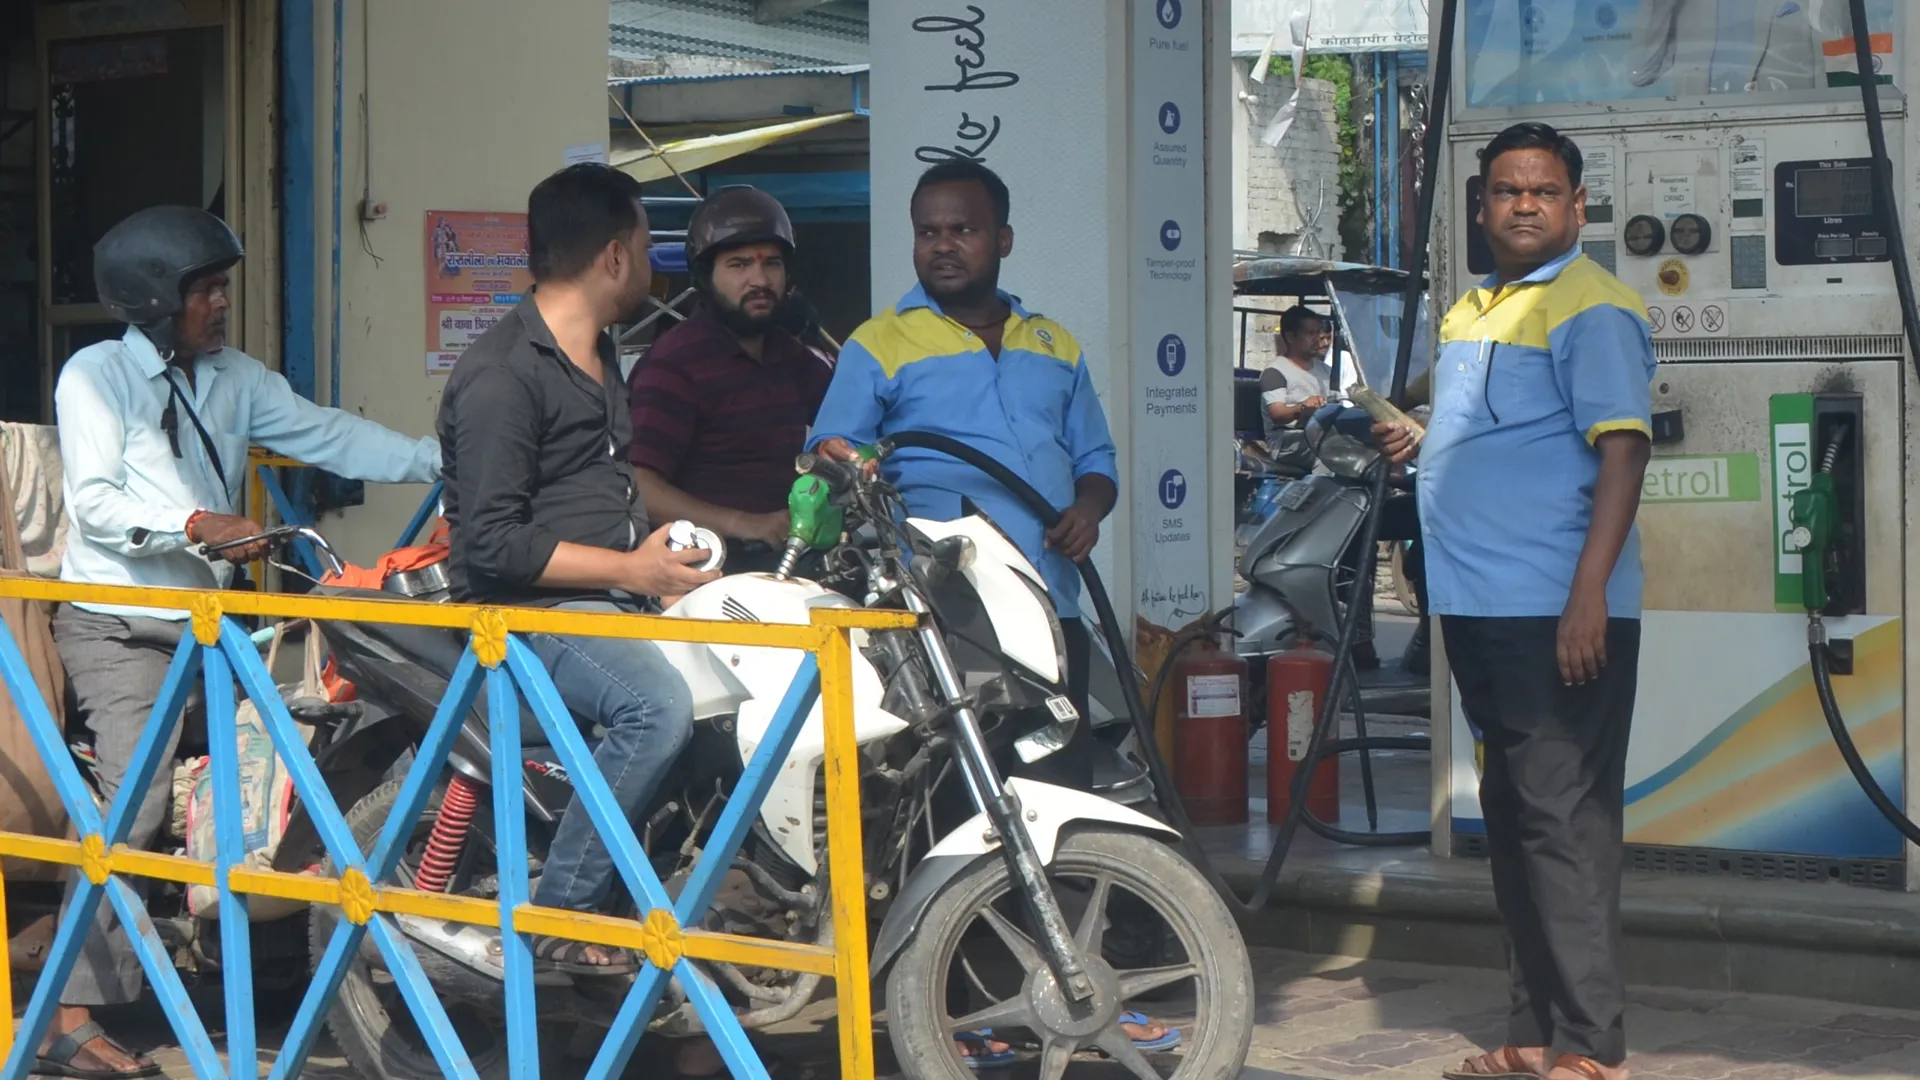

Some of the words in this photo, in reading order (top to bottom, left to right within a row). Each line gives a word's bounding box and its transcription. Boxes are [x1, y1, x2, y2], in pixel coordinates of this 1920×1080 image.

[1148, 37, 1170, 50] Pure
[1172, 39, 1189, 51] fuel
[1153, 142, 1187, 153] Assured
[1153, 154, 1188, 168] Quantity
[1833, 160, 1848, 168] Sale
[1660, 176, 1688, 185] Reserved
[1823, 217, 1843, 225] Litres
[1145, 257, 1196, 269] Tamper-proof
[1149, 269, 1192, 282] Technology
[441, 316, 453, 331] श्री
[1146, 385, 1198, 401] Integrated
[1146, 402, 1198, 417] Payments
[1642, 460, 1720, 497] etrol
[1162, 518, 1183, 529] SMS
[1155, 533, 1191, 545] Updates
